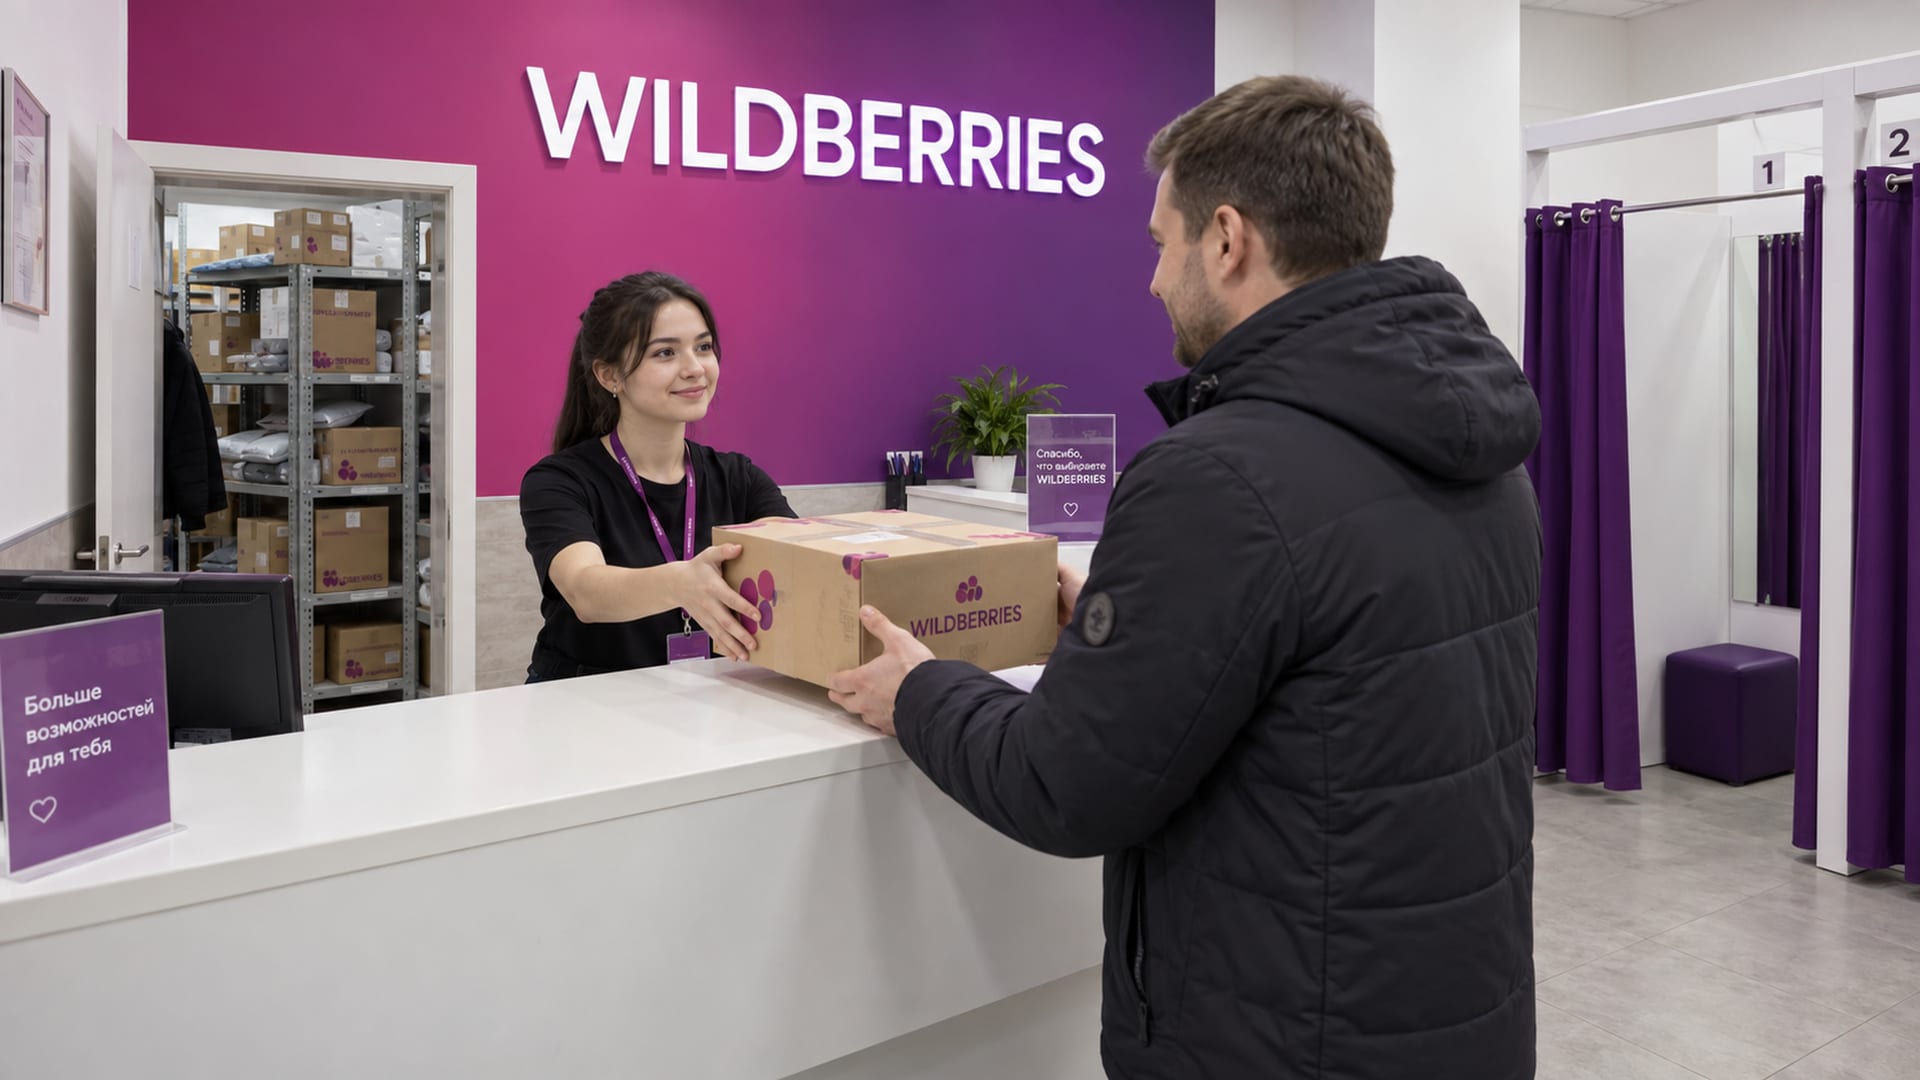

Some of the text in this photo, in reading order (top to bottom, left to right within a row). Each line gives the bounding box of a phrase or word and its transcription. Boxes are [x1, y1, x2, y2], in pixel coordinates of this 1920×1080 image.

[526, 66, 1105, 197] WILDBERRIES
[1889, 128, 1910, 158] 2
[1762, 160, 1773, 184] 1
[1036, 448, 1082, 459] Спасибо,
[910, 604, 1022, 638] WILDBERRIES
[25, 686, 102, 715] Больше
[26, 698, 154, 744] возможностей
[27, 737, 112, 776] для тебя
